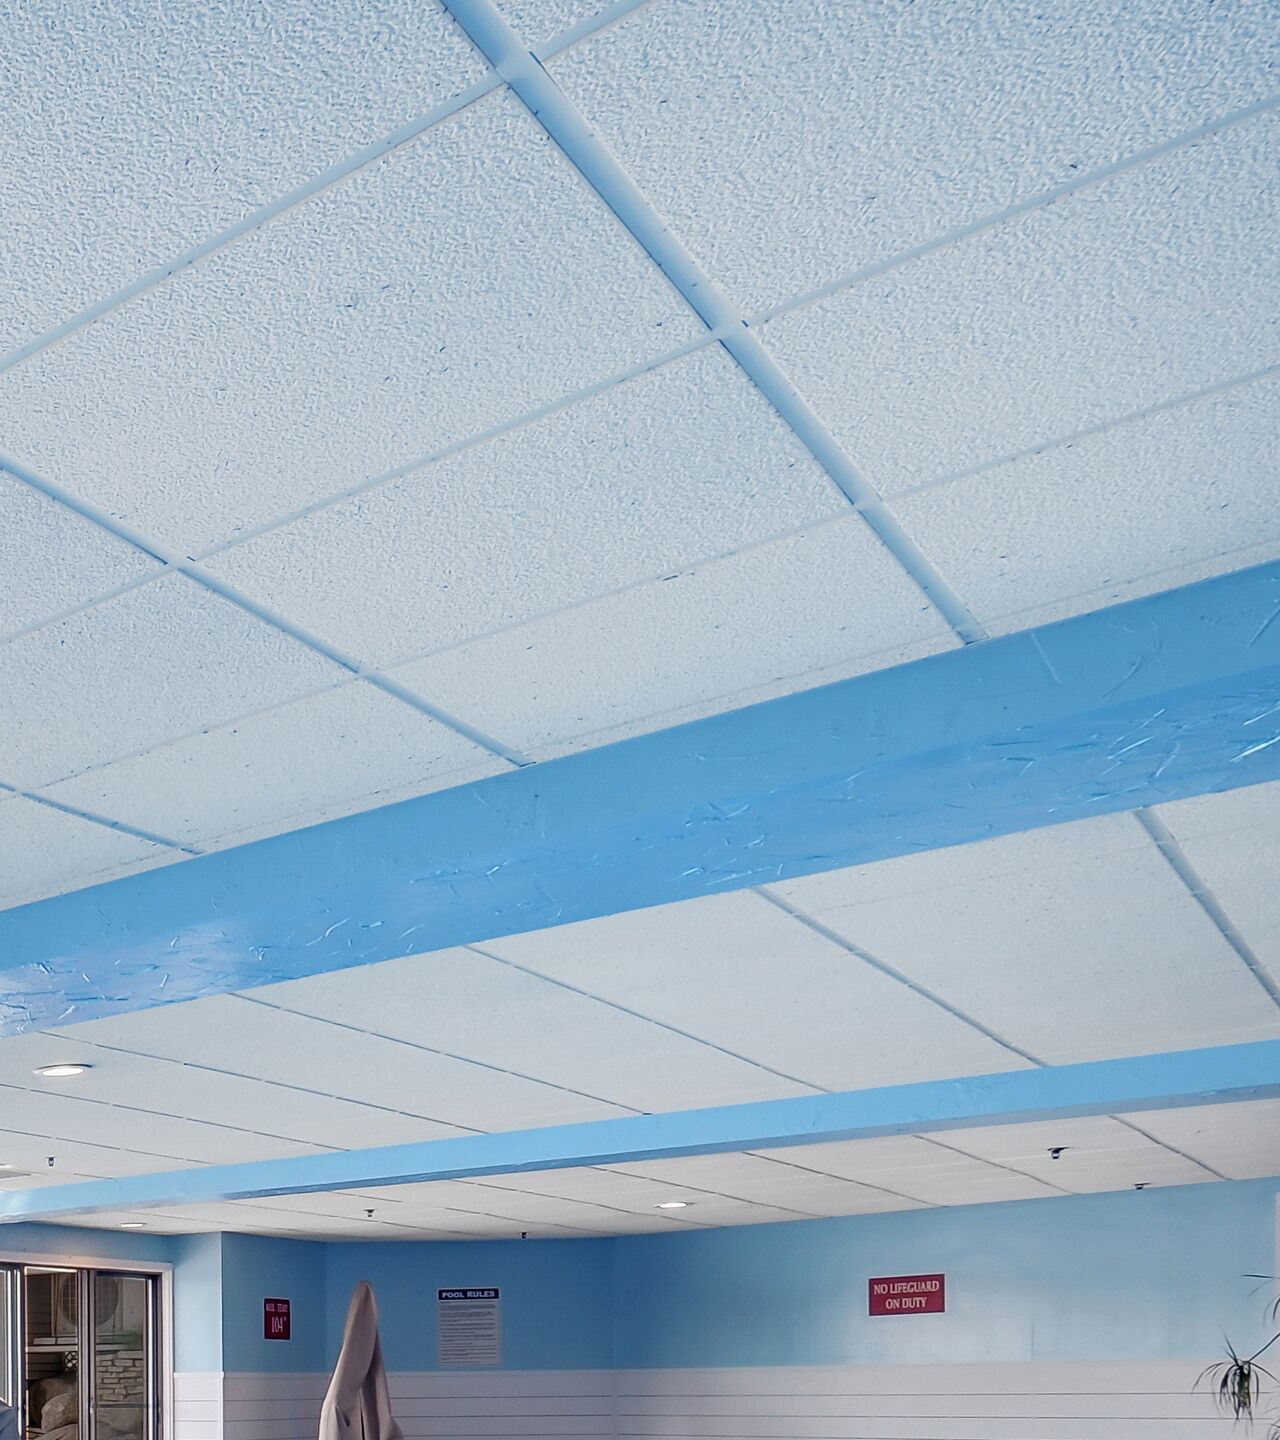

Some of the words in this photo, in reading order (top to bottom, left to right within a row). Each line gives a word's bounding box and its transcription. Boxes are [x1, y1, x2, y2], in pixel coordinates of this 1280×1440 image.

[467, 1290, 495, 1298] RULES
[873, 1284, 888, 1295] NO
[889, 1280, 940, 1294] LIFEGUARD
[885, 1298, 900, 1310] ON
[902, 1297, 927, 1309] DUTY
